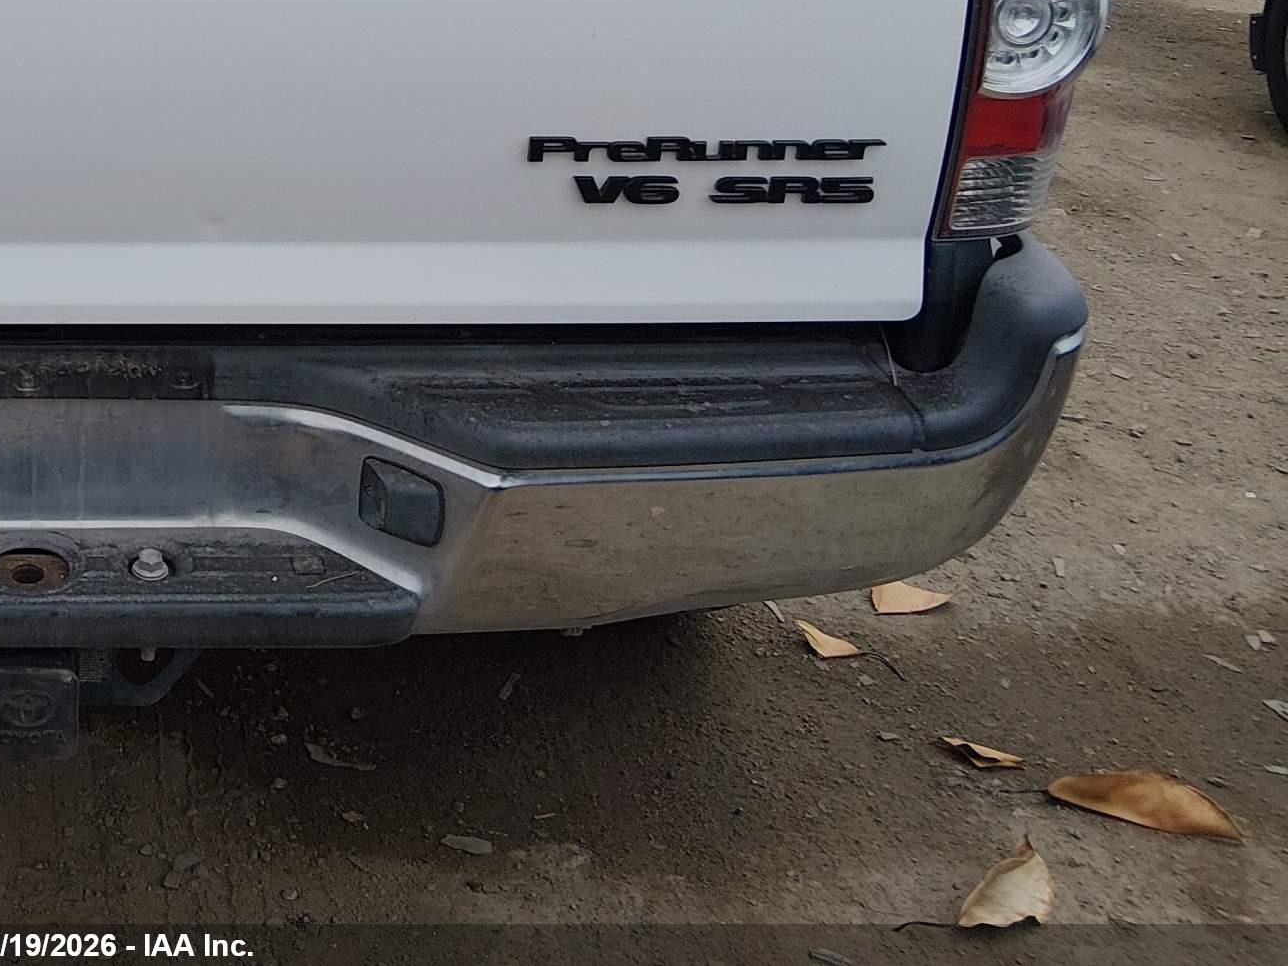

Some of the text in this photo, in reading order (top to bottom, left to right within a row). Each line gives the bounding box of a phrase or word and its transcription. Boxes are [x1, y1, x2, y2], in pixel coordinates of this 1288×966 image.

[526, 136, 888, 163] PreRunner
[572, 175, 875, 205] V6 SR5
